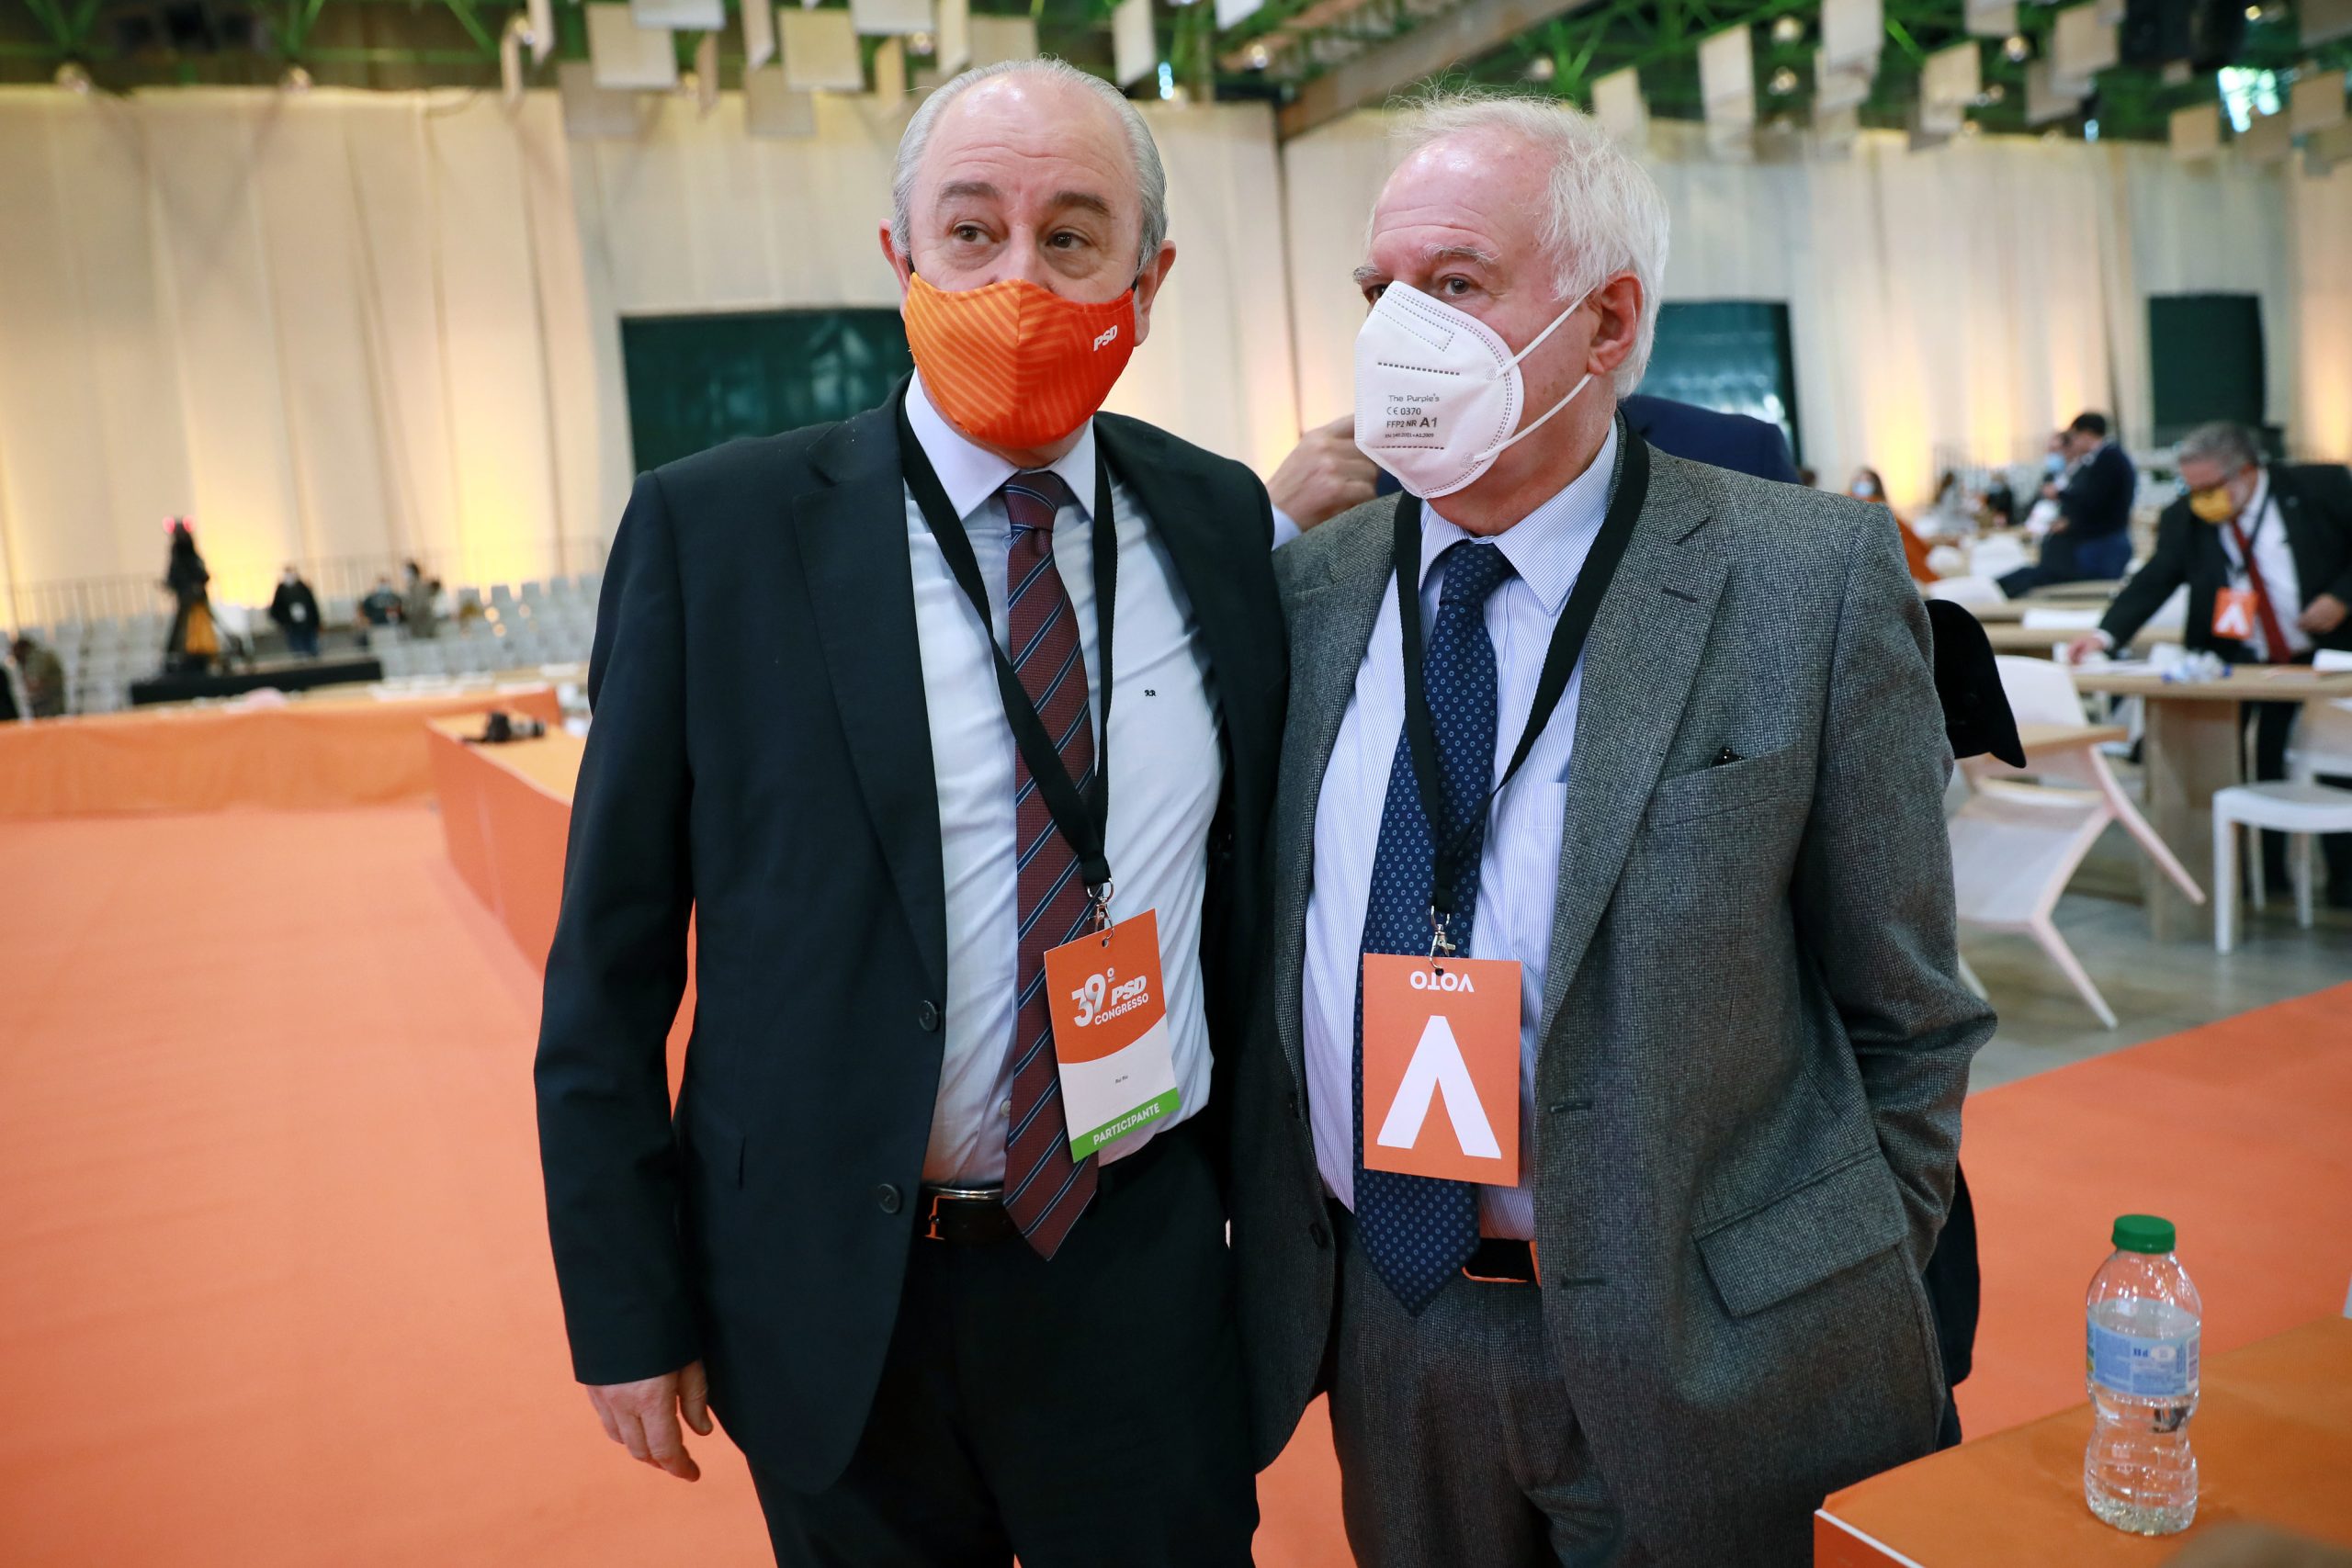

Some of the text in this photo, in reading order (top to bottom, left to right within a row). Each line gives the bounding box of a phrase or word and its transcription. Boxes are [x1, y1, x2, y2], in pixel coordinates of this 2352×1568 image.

[1093, 324, 1118, 352] PSD
[1388, 394, 1404, 402] The
[1386, 420, 1405, 428] FFP2
[1419, 417, 1438, 428] A1
[1400, 407, 1421, 415] 0370
[1111, 976, 1147, 1006] PSD
[1409, 970, 1476, 993] VOTO
[1094, 993, 1148, 1025] CONGRESSO
[1093, 1102, 1160, 1145] PARTICIPANTE
